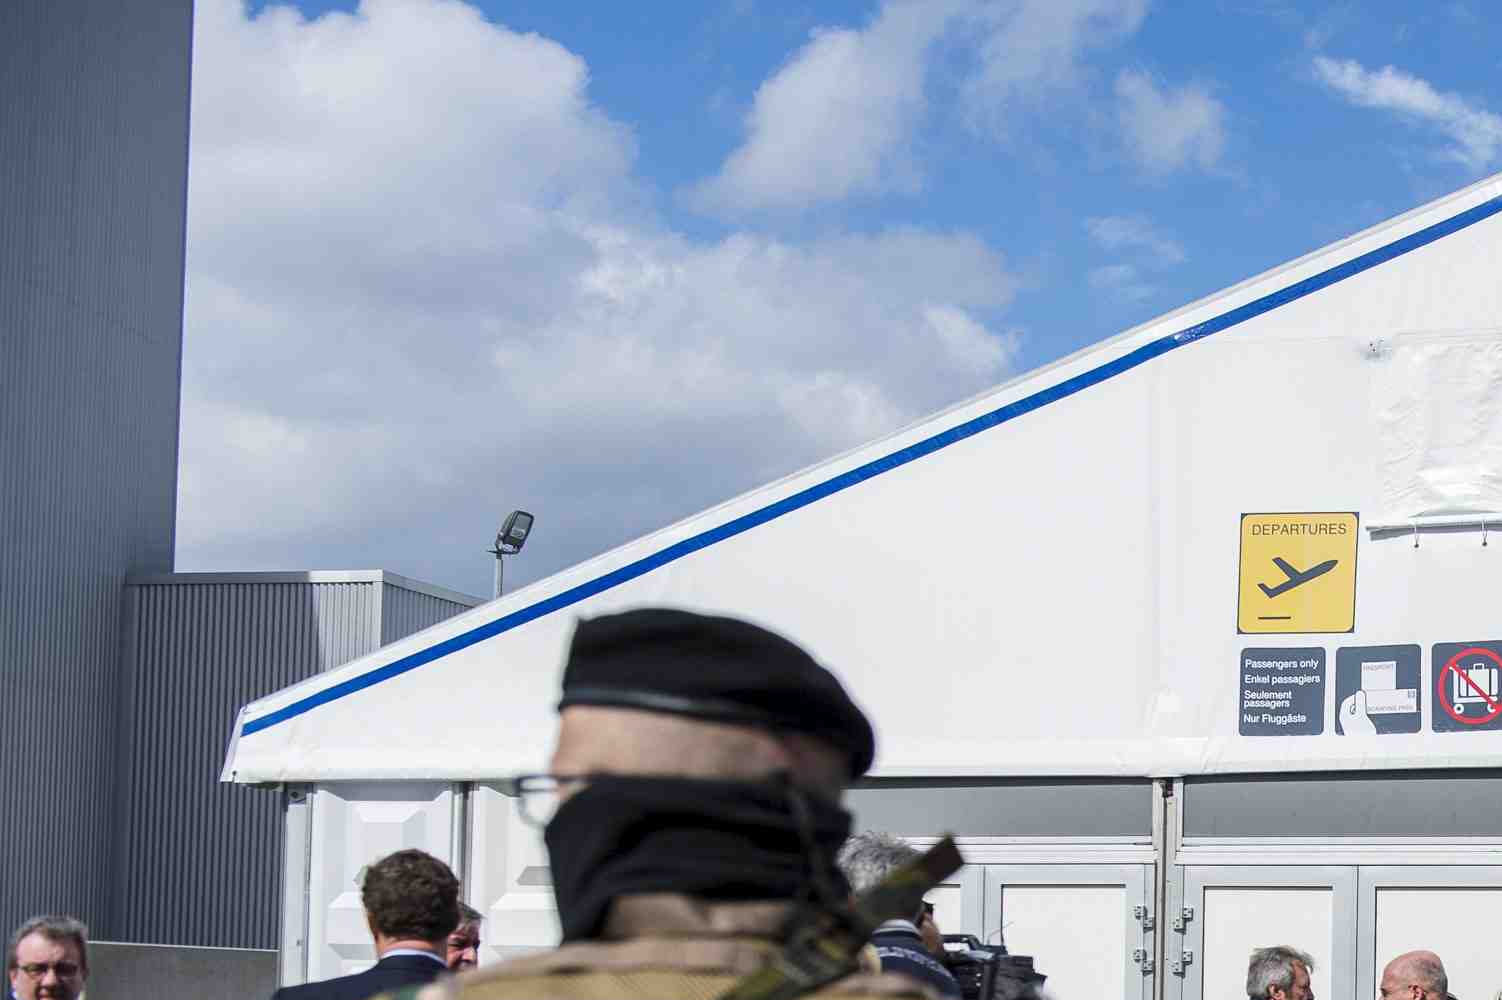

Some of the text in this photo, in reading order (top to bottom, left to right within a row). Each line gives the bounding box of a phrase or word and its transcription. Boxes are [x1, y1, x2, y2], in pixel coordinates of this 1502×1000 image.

[1251, 523, 1347, 536] DEPARTURES
[1245, 659, 1319, 670] Passengers only
[1244, 674, 1321, 686] Enkel passagiers
[1244, 690, 1292, 699] Seulement
[1243, 700, 1290, 710] passagers
[1243, 713, 1307, 725] Nur Fluggäste
